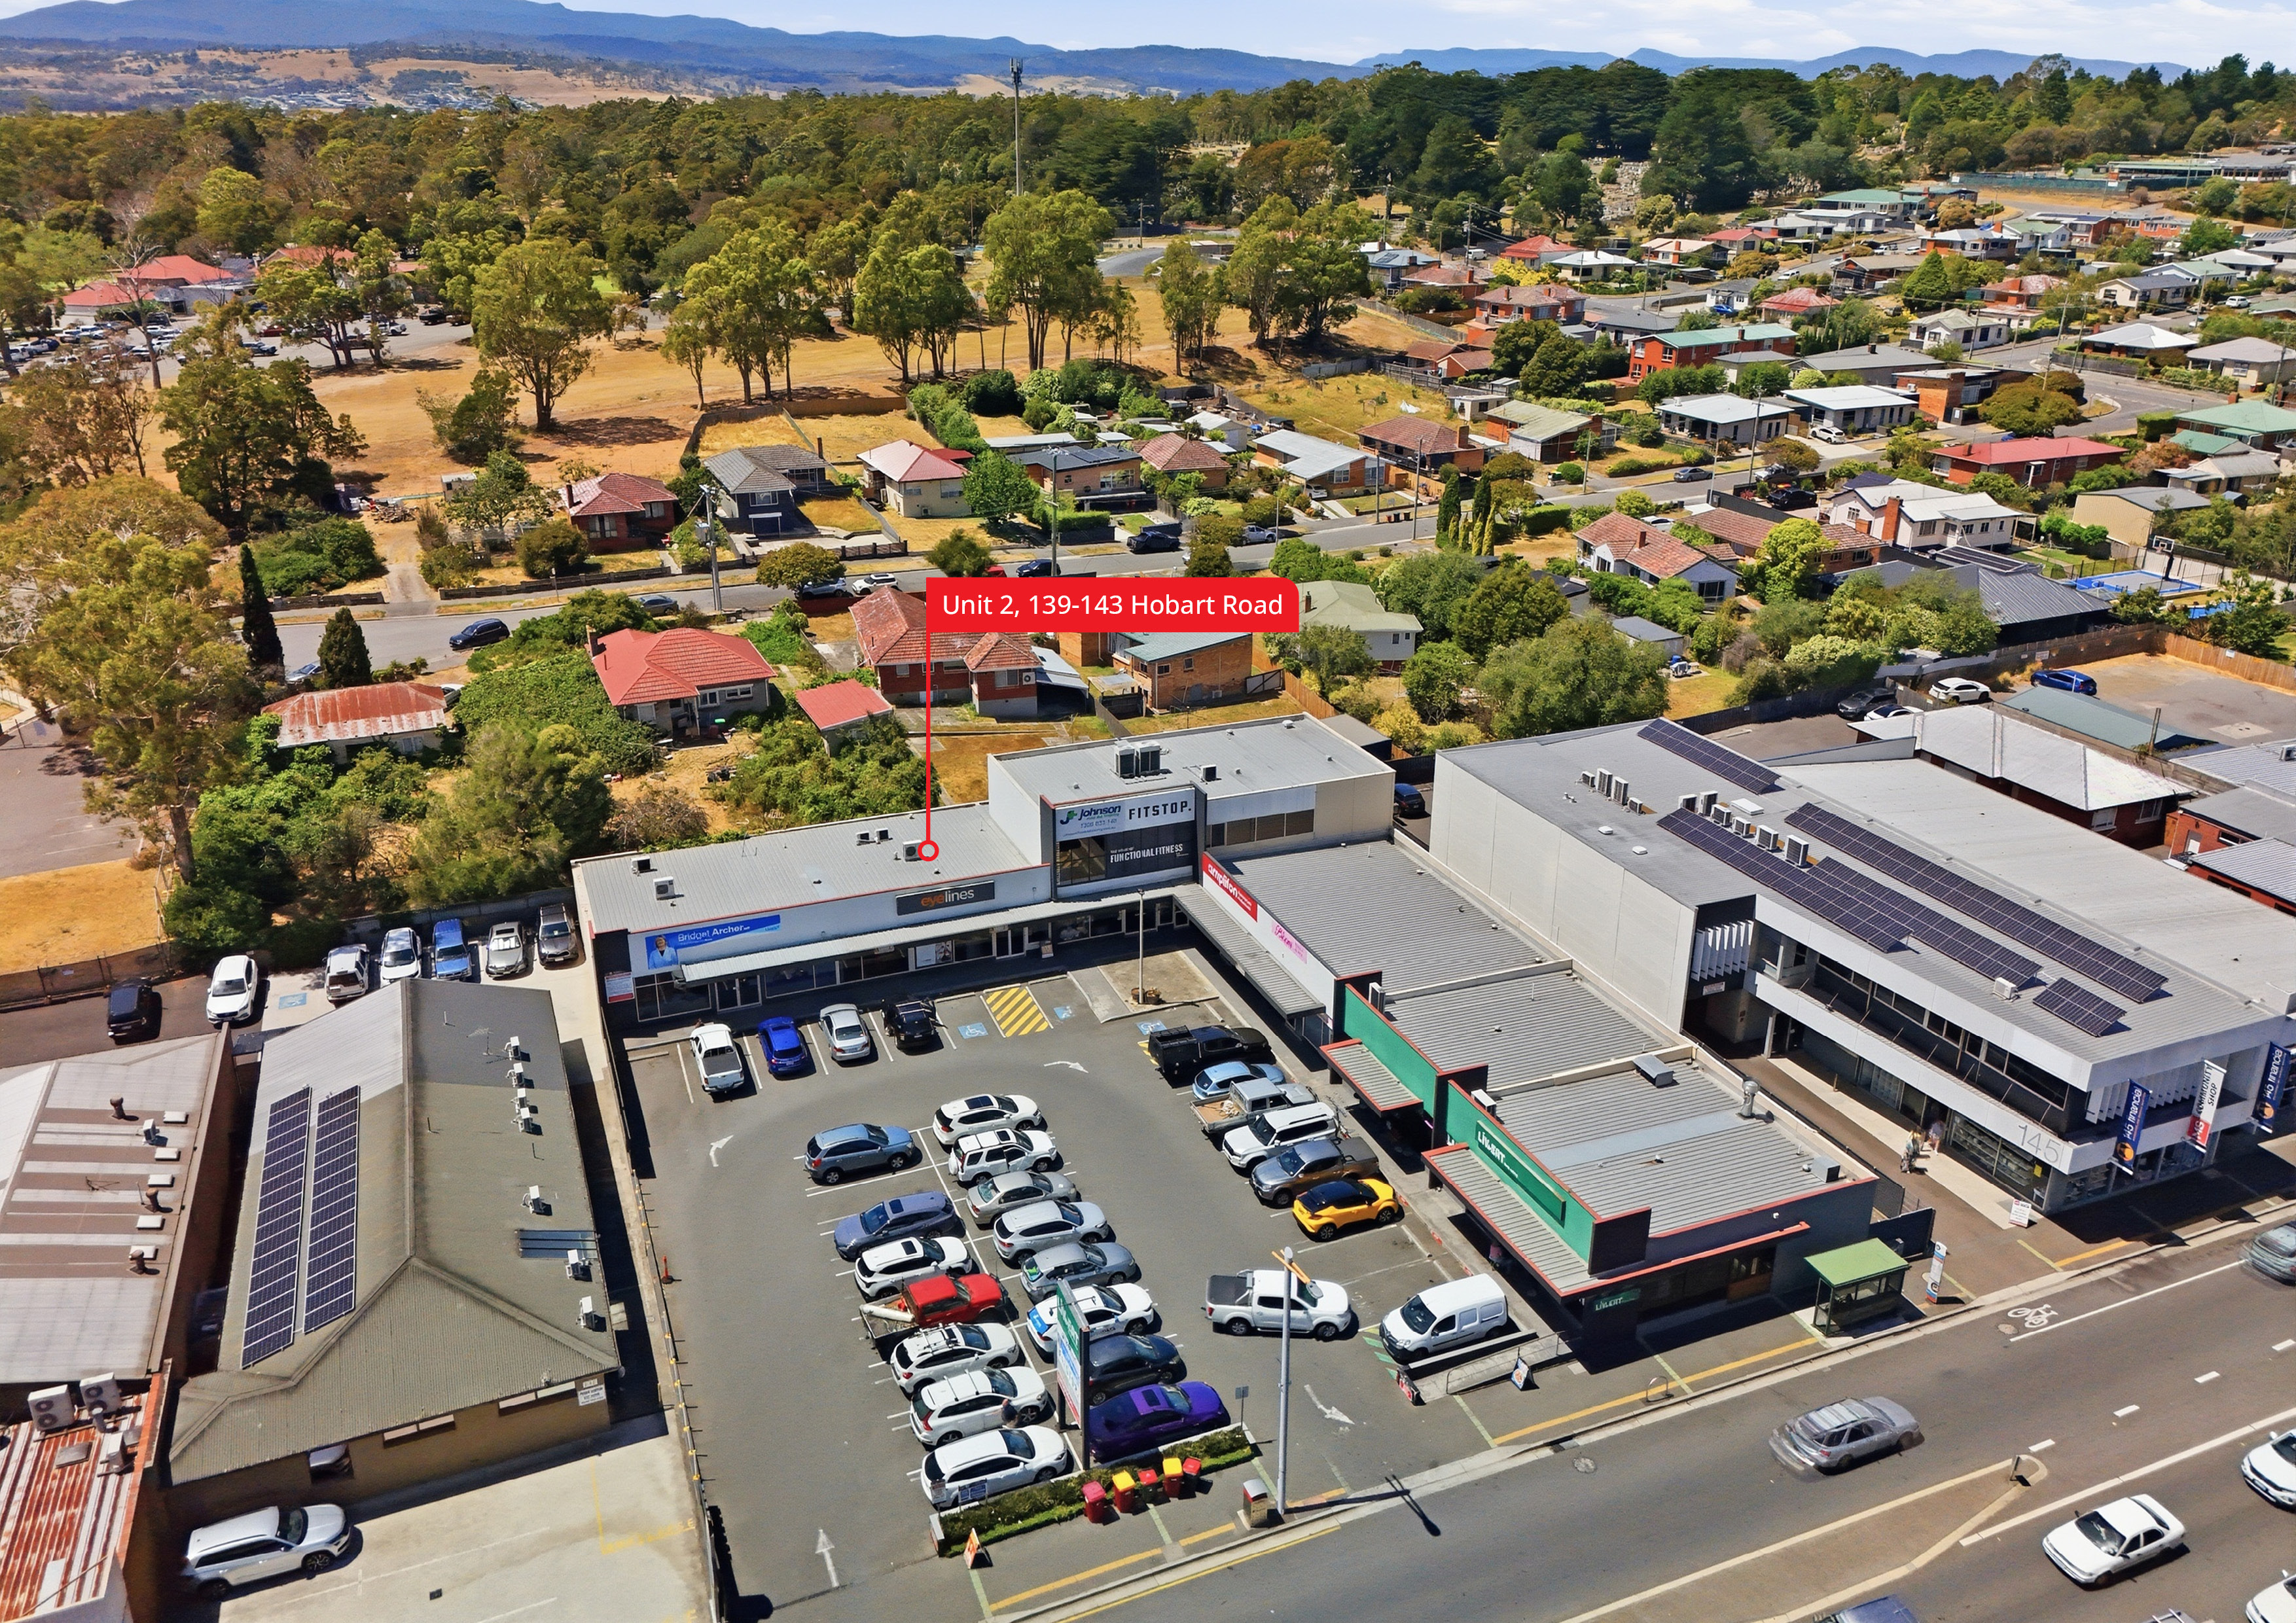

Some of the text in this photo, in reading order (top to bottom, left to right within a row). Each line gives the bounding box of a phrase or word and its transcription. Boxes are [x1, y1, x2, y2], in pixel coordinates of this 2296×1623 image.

[1078, 804, 1121, 821] Johnson
[1128, 800, 1192, 820] FITSTOP.
[1110, 849, 1155, 863] FUNCTIONAL
[1155, 844, 1183, 856] FITNESS
[1208, 863, 1238, 898] amplifon
[920, 889, 975, 908] eyelines
[678, 929, 711, 942] Bridget
[711, 924, 744, 936] Archer
[2196, 1063, 2213, 1114] COMMUNITY
[2208, 1083, 2217, 1106] SHOP
[2018, 1124, 2059, 1163] 145
